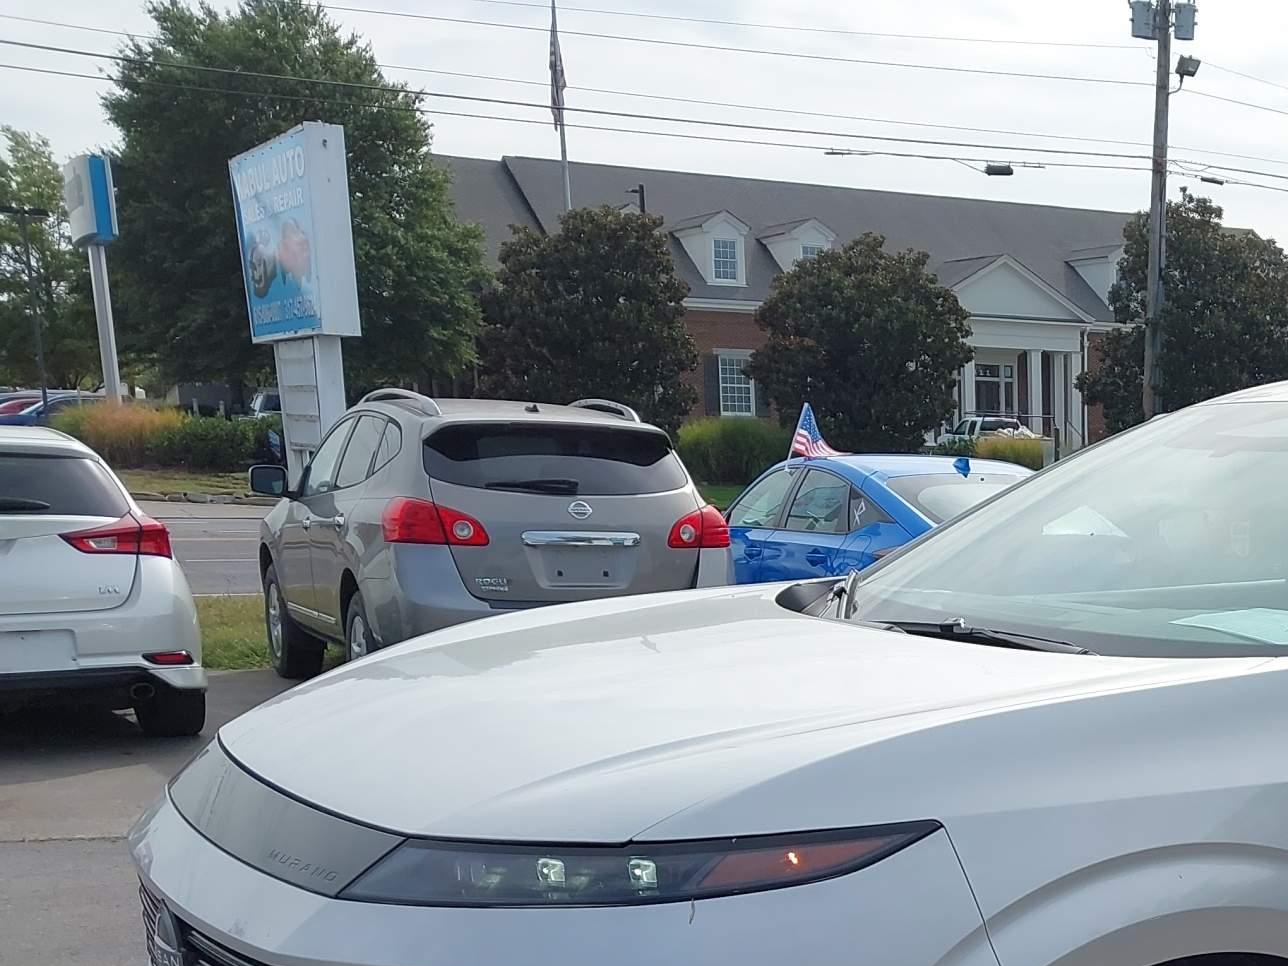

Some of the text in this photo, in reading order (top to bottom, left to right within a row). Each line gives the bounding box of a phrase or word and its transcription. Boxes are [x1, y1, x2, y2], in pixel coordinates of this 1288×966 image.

[273, 146, 304, 185] AUTO
[274, 188, 304, 212] REPAIR
[268, 848, 337, 881] MURANO
